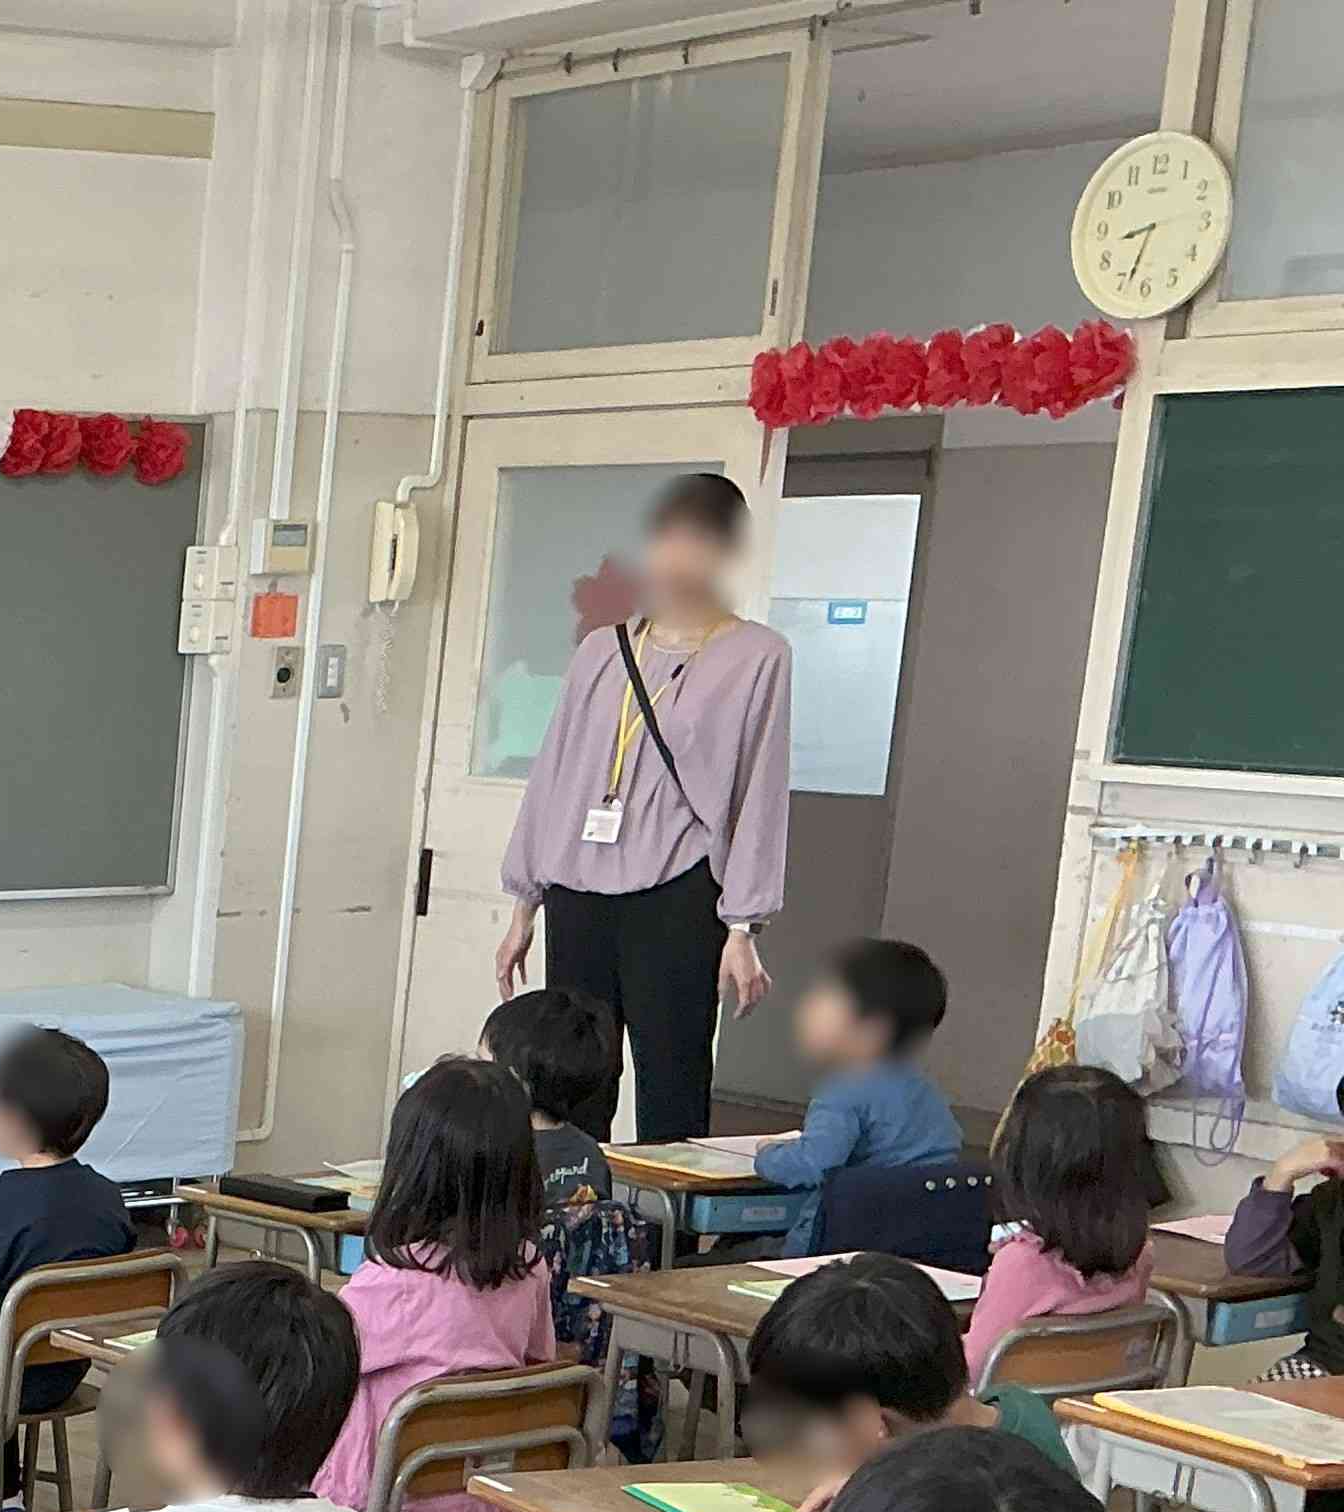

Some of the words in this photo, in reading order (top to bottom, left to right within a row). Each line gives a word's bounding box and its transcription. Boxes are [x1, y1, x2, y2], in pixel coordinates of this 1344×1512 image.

[1152, 153, 1170, 175] 12
[1182, 160, 1190, 180] 1
[1127, 166, 1141, 186] 11
[1106, 190, 1122, 210] 10
[1195, 180, 1209, 201] 2
[1096, 220, 1109, 241] 9
[1199, 211, 1212, 231] 3
[1099, 250, 1112, 271] 8
[1186, 243, 1198, 262] 4
[1114, 273, 1127, 291] 7
[1140, 277, 1152, 297] 6
[1166, 268, 1178, 288] 5
